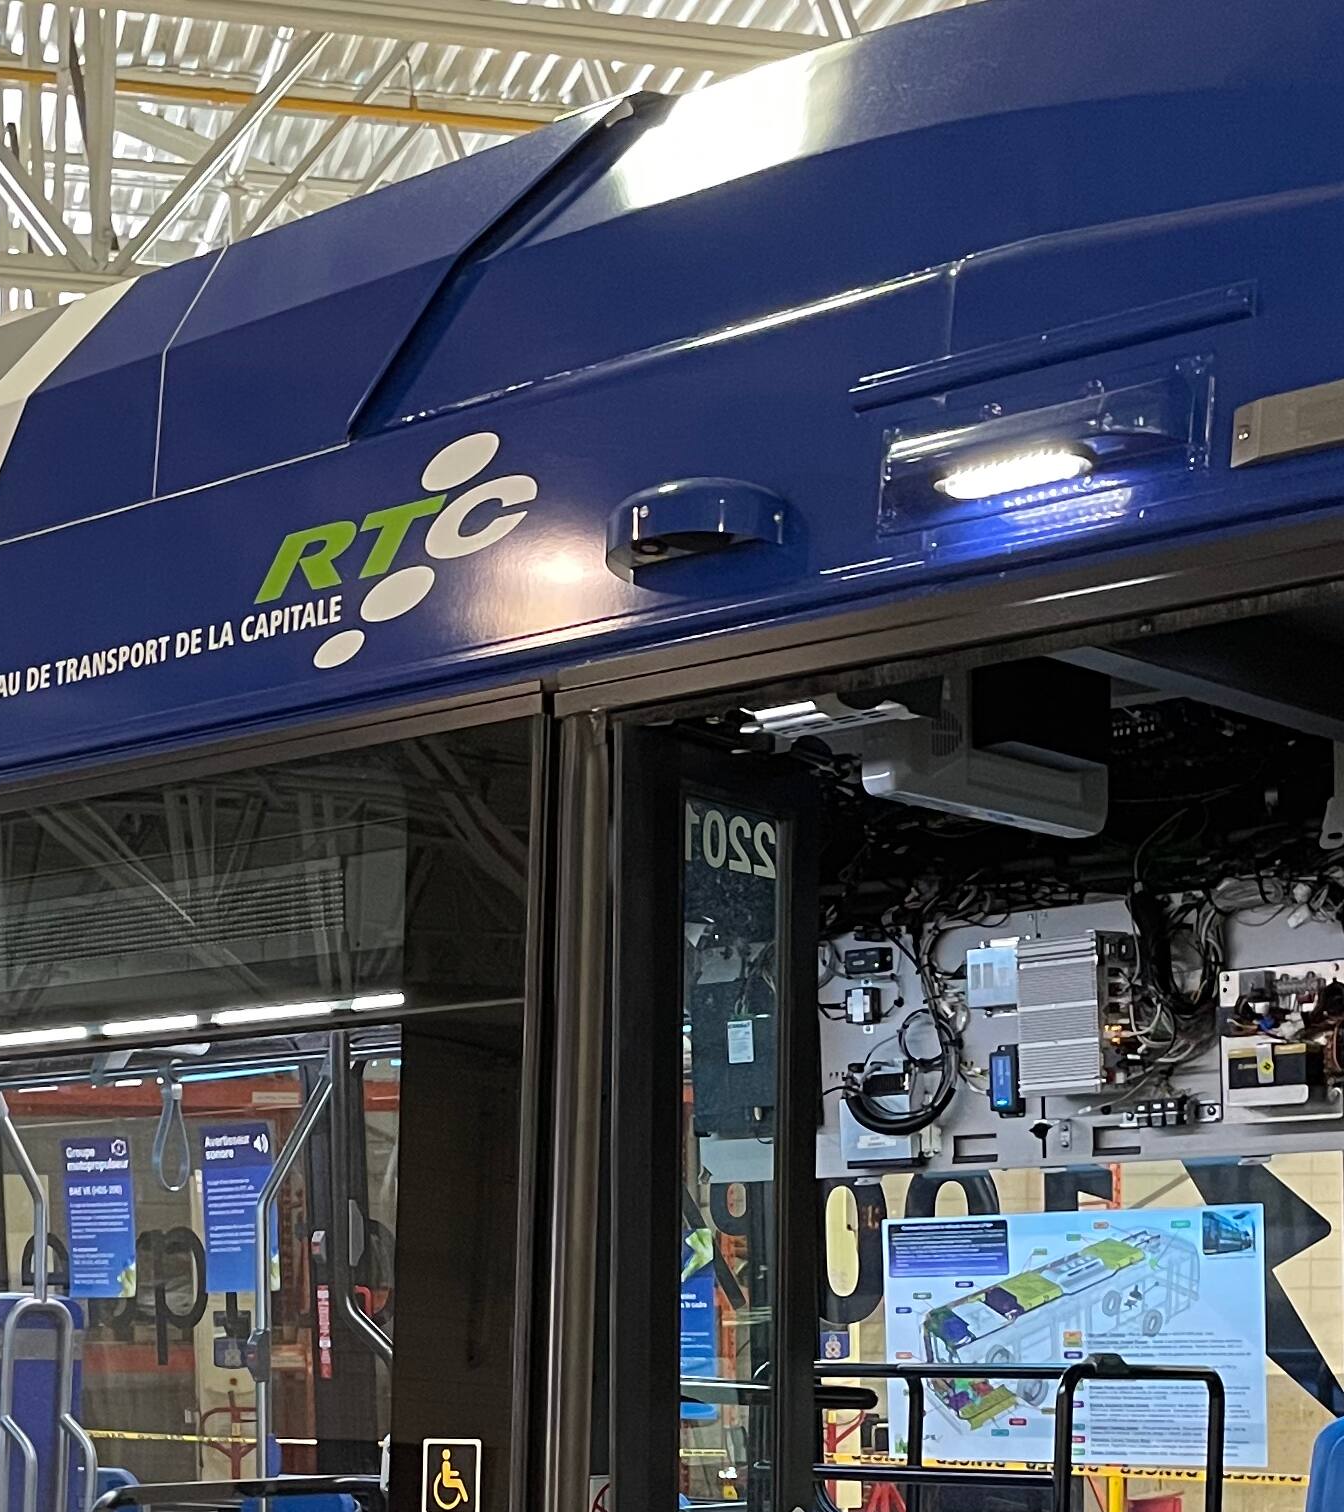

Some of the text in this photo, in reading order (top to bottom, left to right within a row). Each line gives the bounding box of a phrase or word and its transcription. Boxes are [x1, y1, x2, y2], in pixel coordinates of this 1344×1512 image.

[255, 474, 539, 605] RTC
[26, 663, 51, 692] DE
[55, 635, 170, 686] TRANSPORT
[175, 629, 203, 658] DE
[208, 622, 234, 651] LA
[240, 594, 343, 646] CAPITALE
